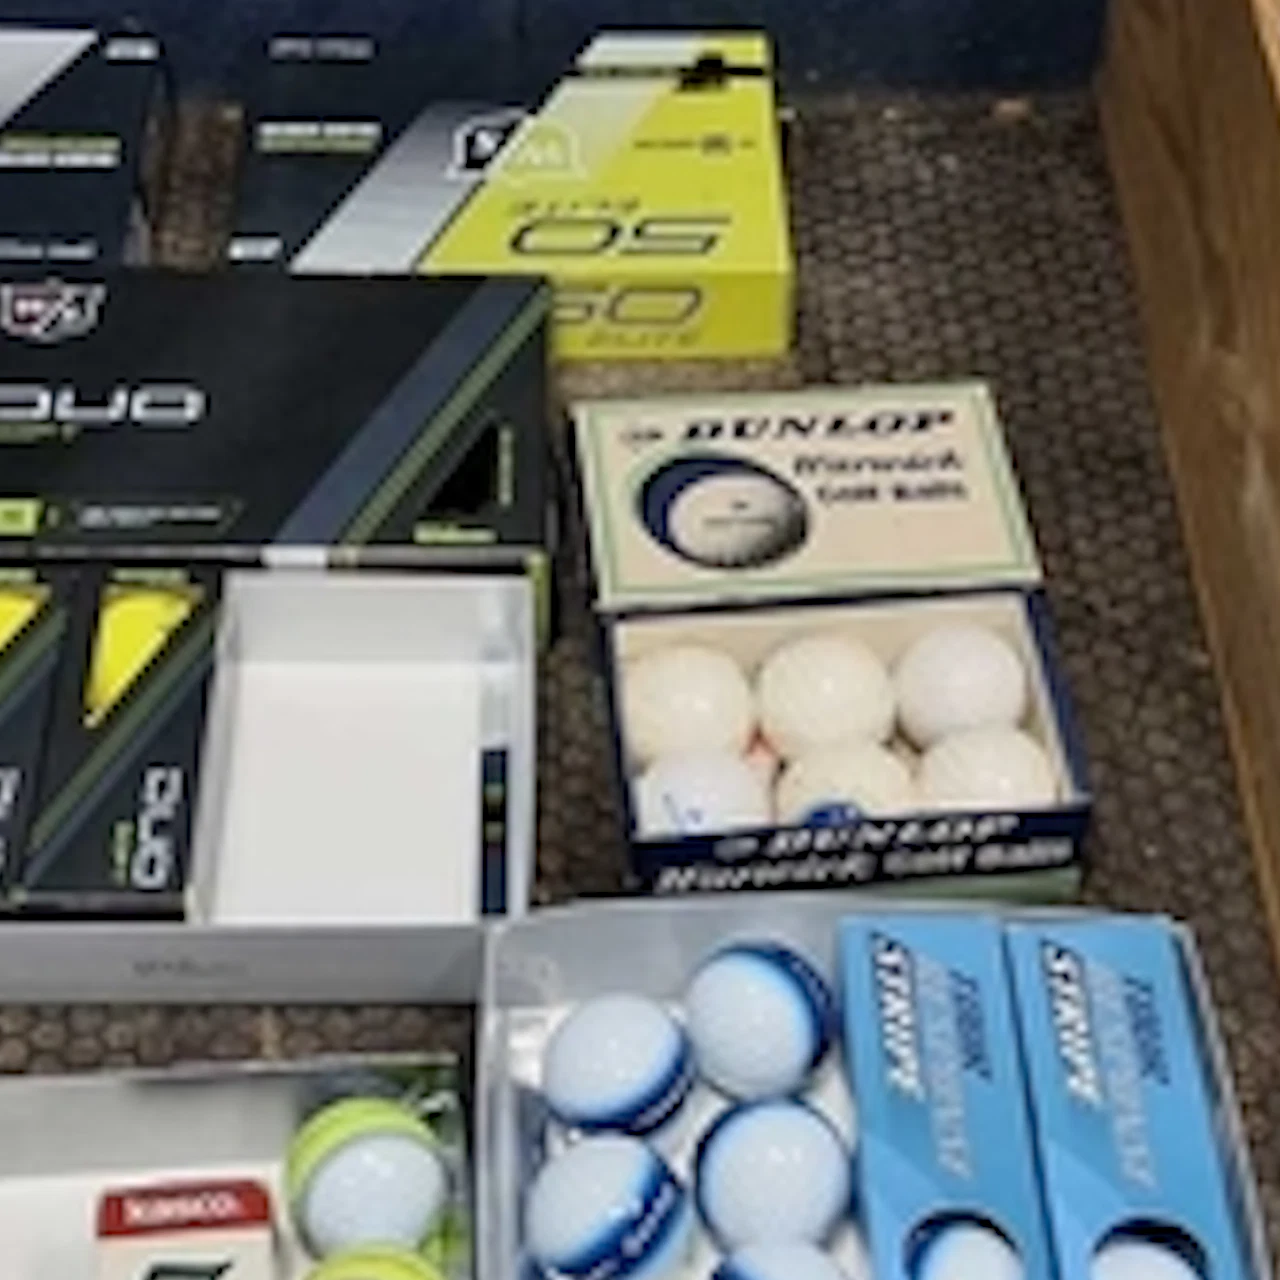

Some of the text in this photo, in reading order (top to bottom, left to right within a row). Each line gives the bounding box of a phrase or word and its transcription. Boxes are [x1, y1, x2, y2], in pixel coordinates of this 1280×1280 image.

[509, 216, 732, 256] 50
[678, 407, 957, 442] DUNLOP
[131, 767, 183, 889] DUO
[764, 814, 1021, 859] DUNLOP
[869, 930, 928, 1104] STRIPE
[1040, 937, 1104, 1114] STRIPE
